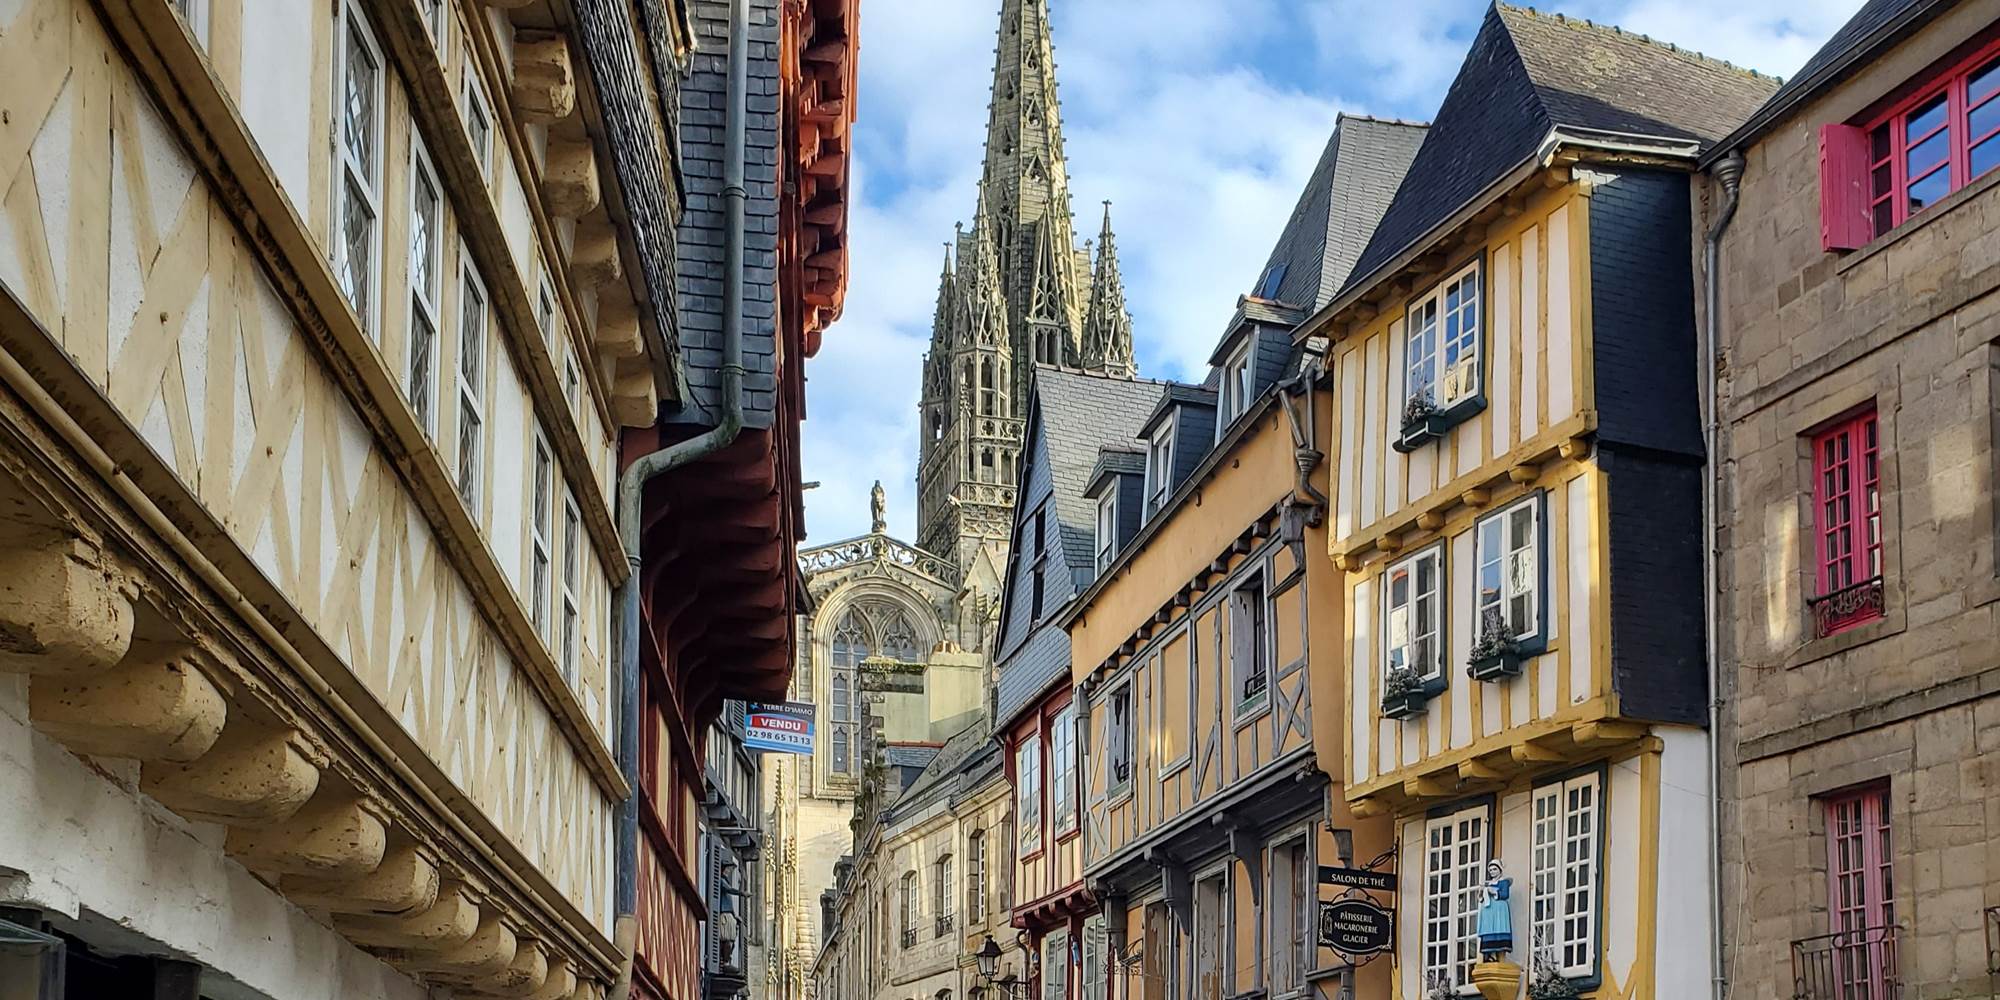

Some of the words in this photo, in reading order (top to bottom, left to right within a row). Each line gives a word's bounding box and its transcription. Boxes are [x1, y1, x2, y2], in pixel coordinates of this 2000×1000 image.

[763, 704, 784, 712] TERRE
[785, 706, 812, 715] D'IMMO
[761, 718, 801, 730] VENDU
[761, 731, 772, 739] 98
[1332, 873, 1357, 884] SALON
[1359, 877, 1369, 885] DE
[1371, 878, 1385, 886] THÉ
[1340, 911, 1372, 922] PÂTISSERIE
[1334, 922, 1378, 934] MACARONERIE
[1343, 934, 1368, 944] GLACIER
